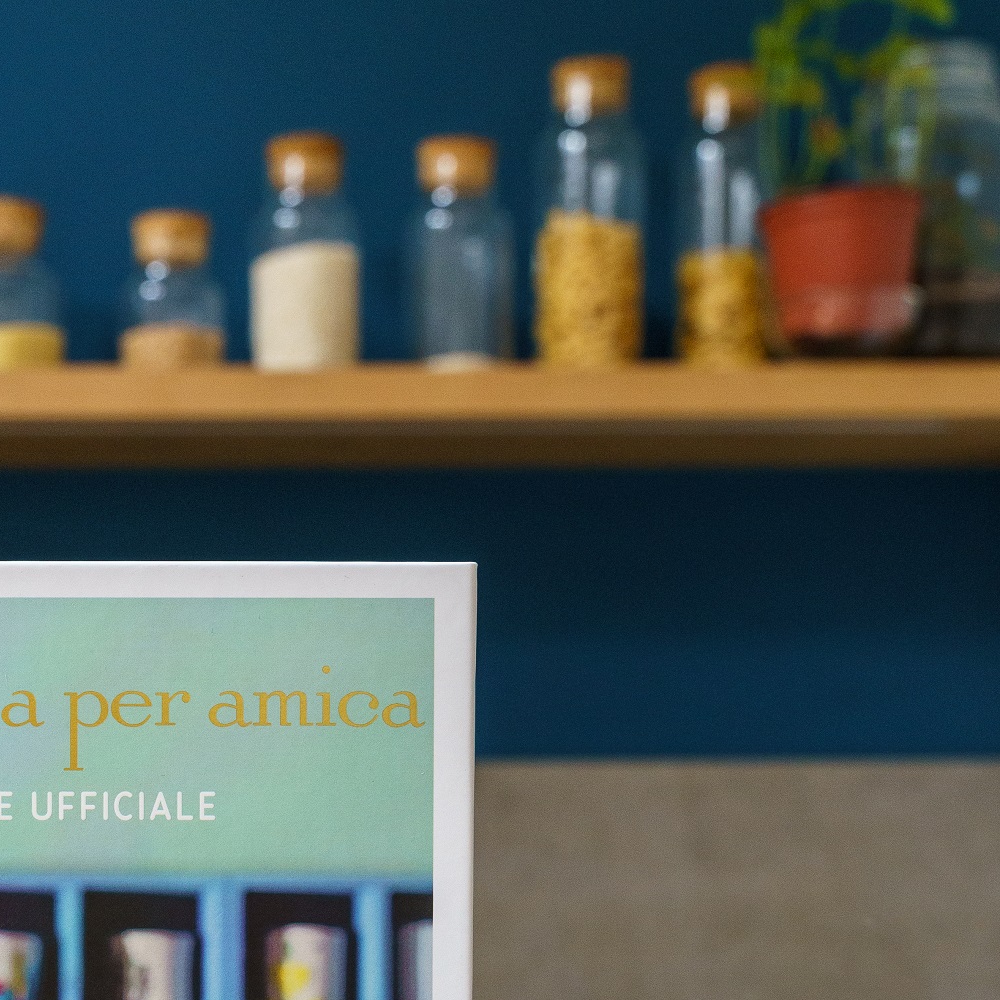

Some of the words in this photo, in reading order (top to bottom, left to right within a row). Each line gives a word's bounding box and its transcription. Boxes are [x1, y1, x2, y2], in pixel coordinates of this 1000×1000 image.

[63, 689, 191, 772] per
[207, 665, 425, 728] amica
[30, 790, 217, 821] UFFICIALE
